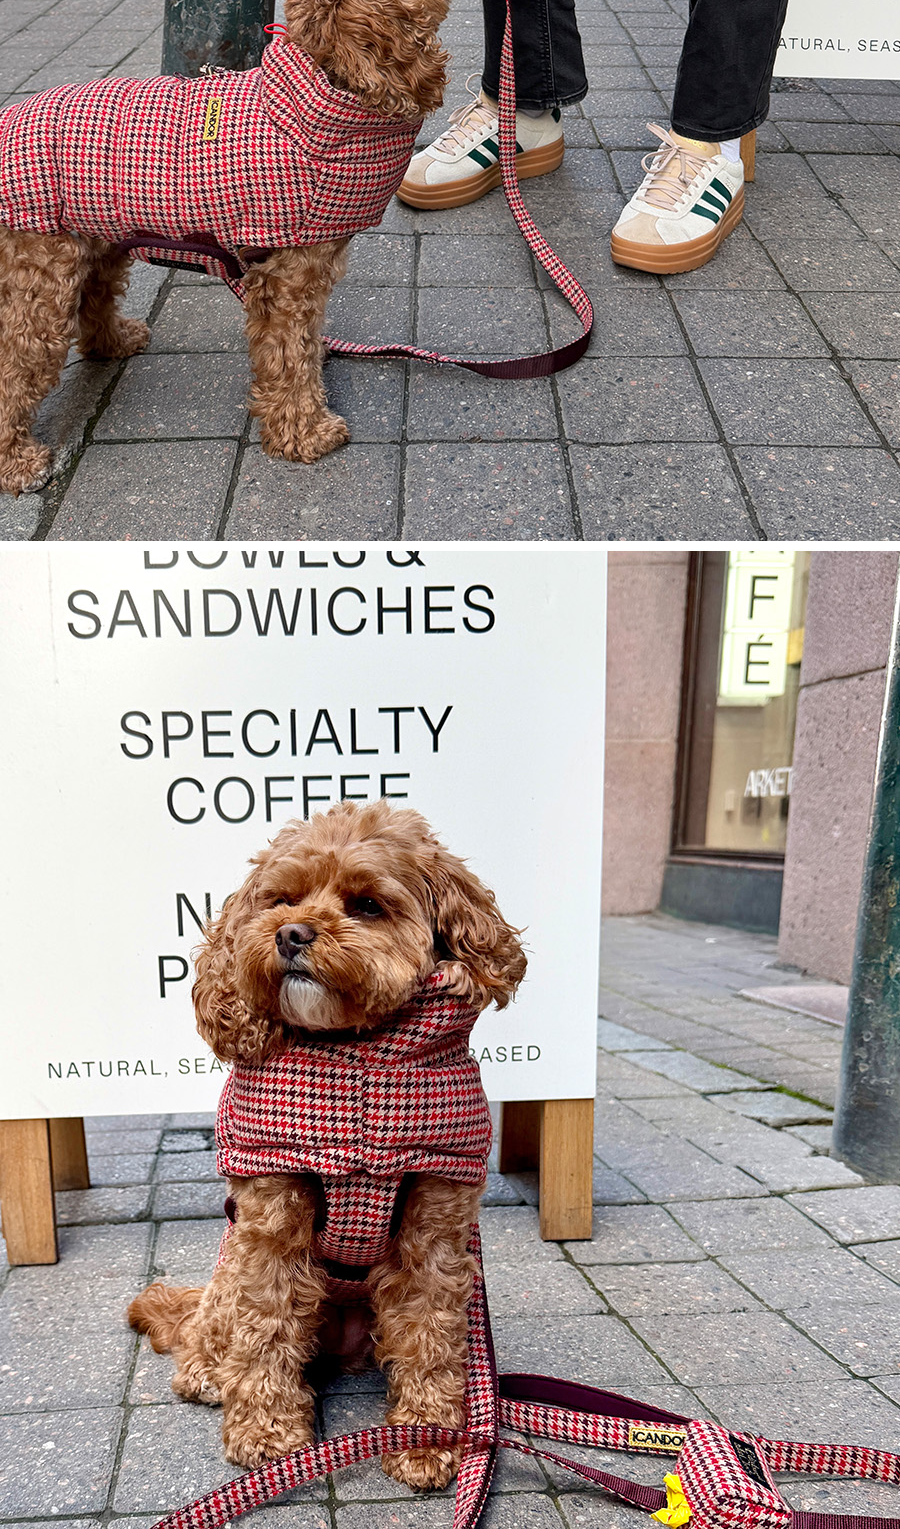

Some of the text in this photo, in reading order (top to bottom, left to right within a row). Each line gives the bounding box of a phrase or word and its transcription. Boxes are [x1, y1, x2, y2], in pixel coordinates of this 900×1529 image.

[778, 37, 851, 53] ATURAL,
[66, 584, 496, 639] SANDWICHES
[119, 705, 454, 759] SPECIALTY
[47, 1059, 169, 1078] NATURAL,
